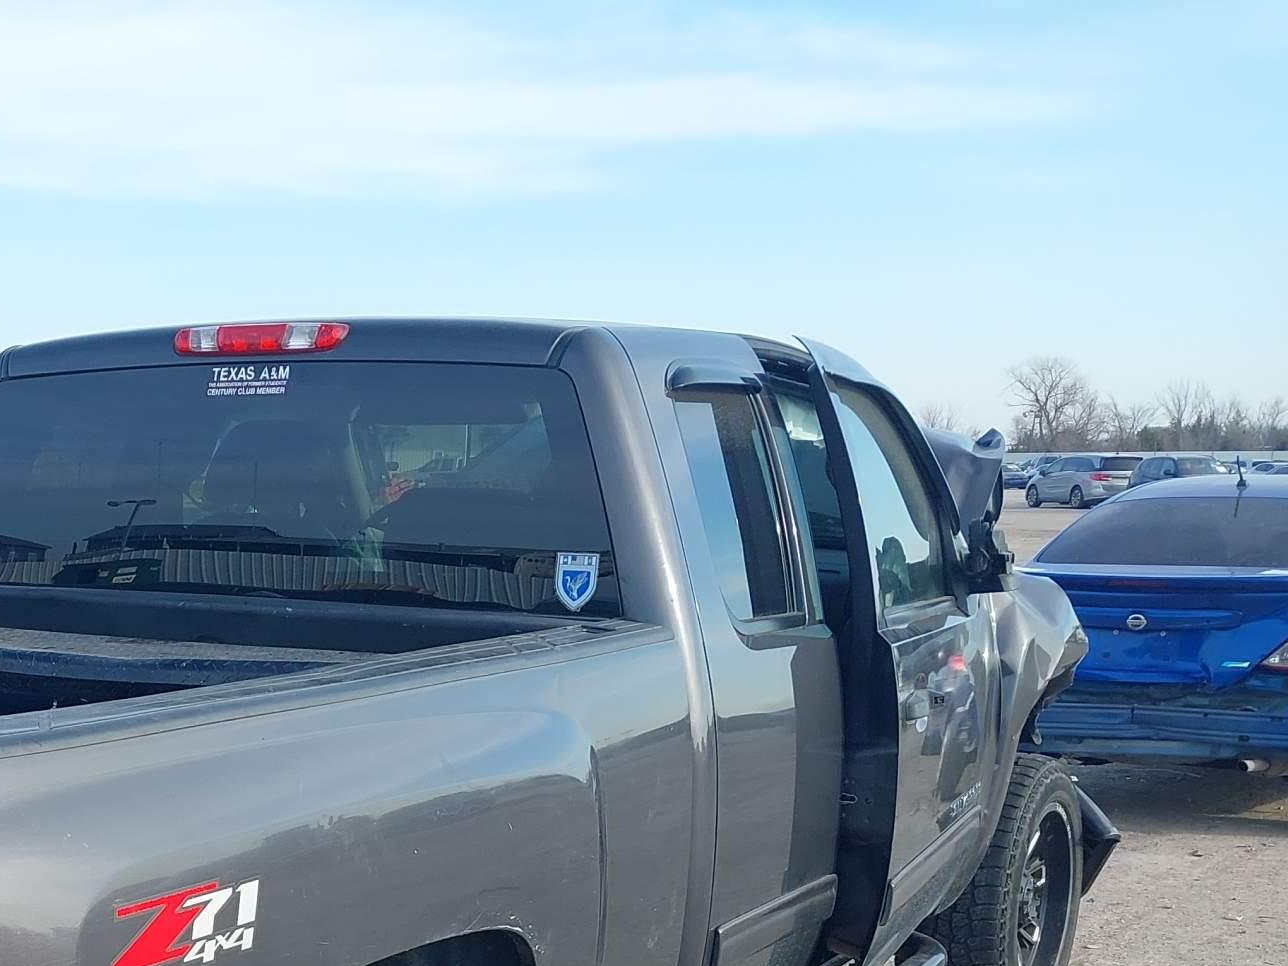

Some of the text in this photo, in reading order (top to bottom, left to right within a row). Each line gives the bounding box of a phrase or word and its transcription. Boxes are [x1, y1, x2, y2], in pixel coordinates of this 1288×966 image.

[212, 365, 290, 381] TEXAS A&M
[207, 386, 286, 396] CENTURY CLUB MEMBER
